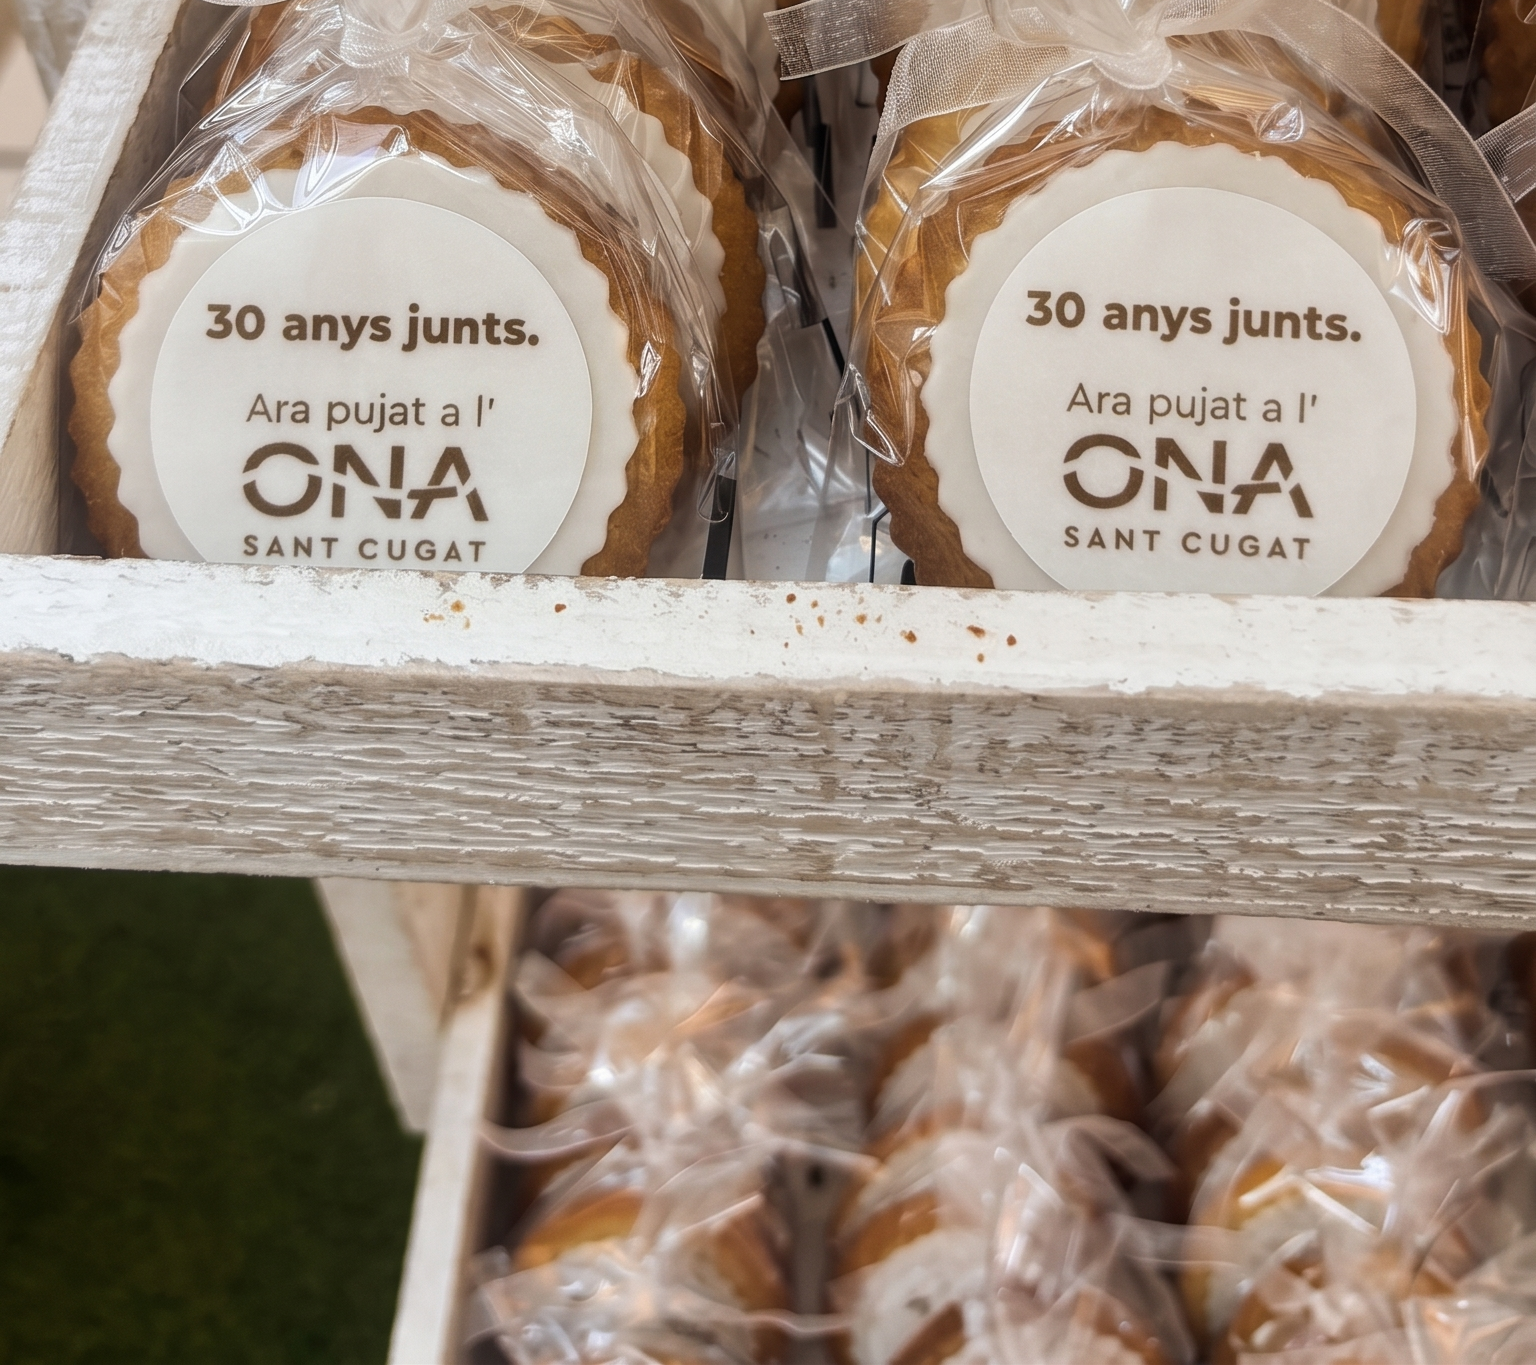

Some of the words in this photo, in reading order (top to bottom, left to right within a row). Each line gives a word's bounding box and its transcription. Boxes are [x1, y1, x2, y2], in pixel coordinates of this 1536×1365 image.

[205, 303, 266, 341] 30
[282, 313, 392, 352] anys
[401, 302, 540, 353] junts.
[1025, 290, 1086, 329] 30
[1102, 302, 1213, 343] anys
[1222, 296, 1362, 346] junts.
[245, 393, 310, 424] Ara
[326, 392, 426, 434] pujat
[440, 403, 460, 427] a
[477, 394, 495, 428] l'
[1066, 382, 1132, 416] Ara
[1148, 386, 1247, 427] pujat
[1261, 398, 1282, 423] a
[1298, 392, 1318, 424] l'
[242, 441, 489, 523] ONA
[1062, 433, 1314, 519] ONA
[243, 534, 339, 559] SANT
[357, 538, 487, 563] CUGAT
[1063, 525, 1161, 552] SANT
[1181, 531, 1311, 560] CUGAT
